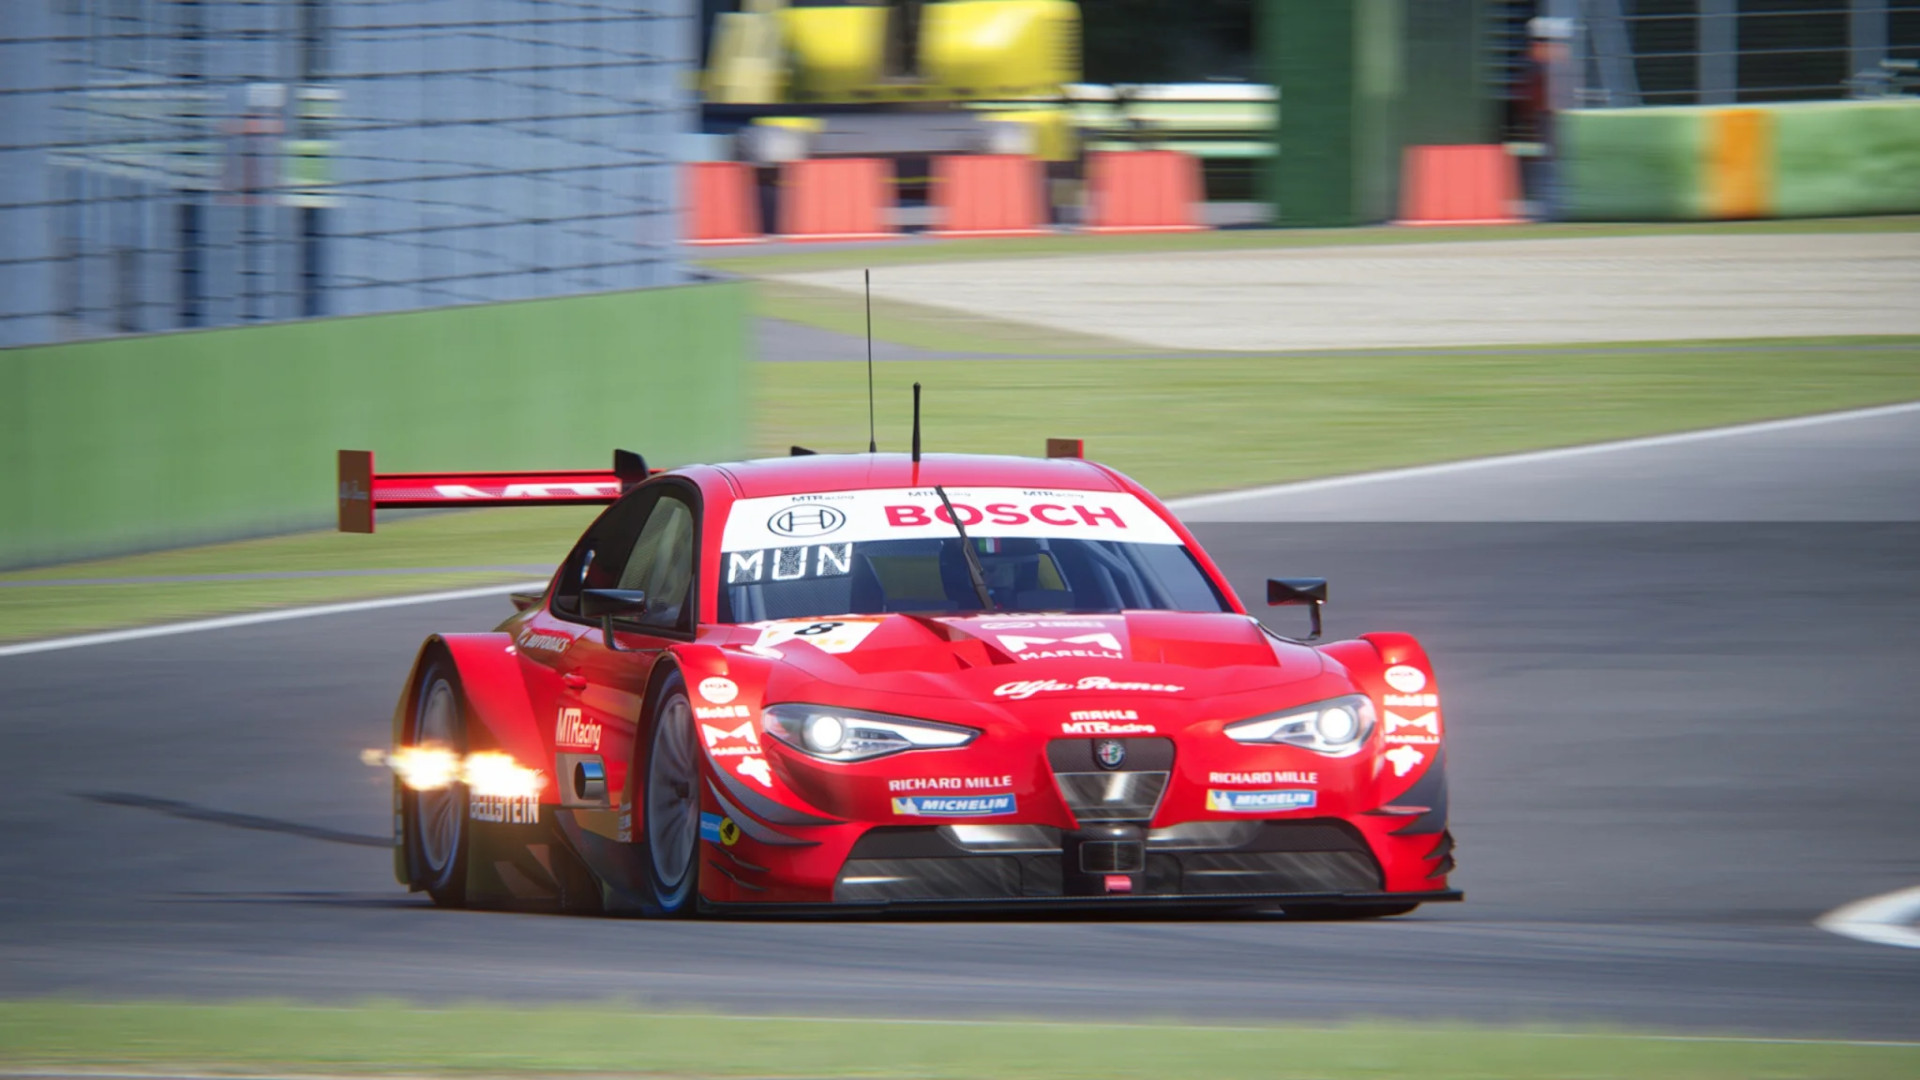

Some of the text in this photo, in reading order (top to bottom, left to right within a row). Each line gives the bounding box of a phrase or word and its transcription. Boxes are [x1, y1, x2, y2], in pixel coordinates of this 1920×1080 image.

[884, 503, 1127, 529] BOSCH
[728, 542, 853, 584] MUN
[794, 622, 844, 636] 8
[1018, 649, 1123, 660] MARELLI
[993, 676, 1185, 699] Alfa Romeo
[1070, 710, 1138, 721] MAHLE
[556, 707, 602, 751] MTRacing
[1062, 722, 1156, 734] MTRacing
[888, 775, 1012, 791] RICHARD MILLE
[1209, 771, 1318, 784] RICHARD MILLE
[921, 798, 1009, 811] MICHELIN
[1235, 793, 1310, 805] MICHELIN
